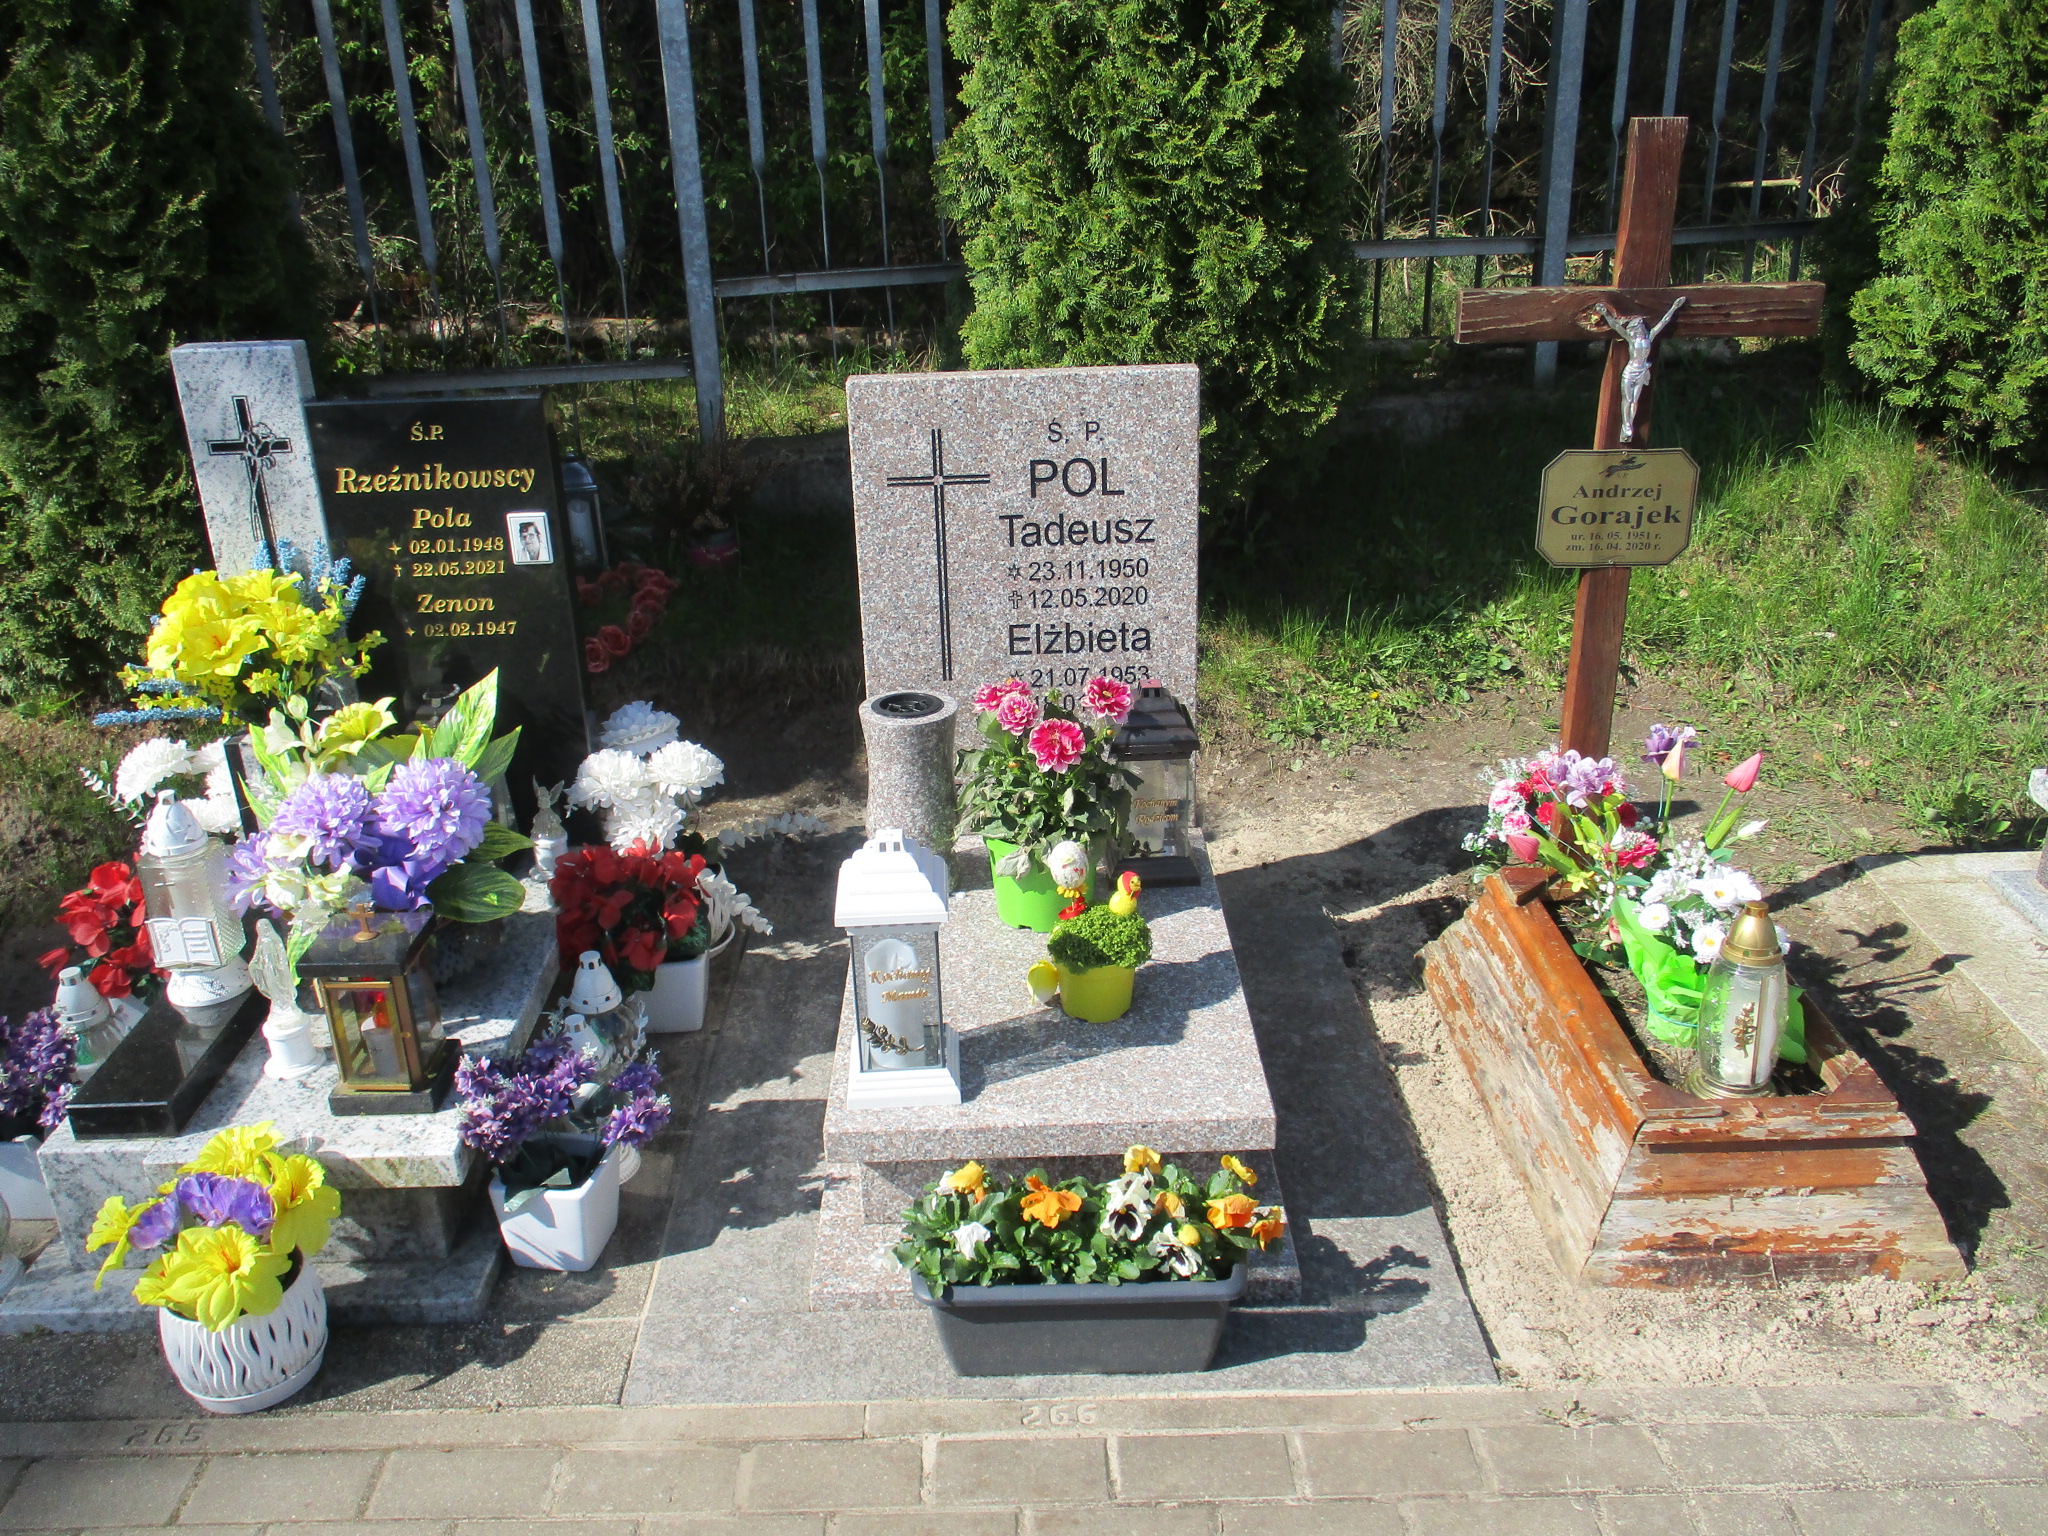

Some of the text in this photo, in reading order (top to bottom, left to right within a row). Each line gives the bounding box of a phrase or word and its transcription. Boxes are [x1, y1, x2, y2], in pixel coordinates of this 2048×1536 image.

[410, 421, 444, 441] Ś.P.
[335, 463, 535, 494] Rzeźnikowscy
[1029, 457, 1125, 498] POL
[1572, 483, 1663, 501] Andrzej
[412, 506, 472, 529] Pola
[1551, 505, 1682, 530] Gorajek
[999, 513, 1155, 548] Tadeusz
[1571, 533, 1585, 541] ur.
[1627, 531, 1650, 540] 1951
[409, 536, 504, 555] 02.01.1948
[1626, 542, 1651, 551] 2020
[412, 560, 505, 577] 22.05.2021
[1029, 558, 1149, 582] 23.11.1950
[417, 593, 495, 613] Zenon
[1029, 586, 1148, 609] 12.05.2020
[424, 620, 517, 637] 02.02.1947
[1008, 621, 1151, 656] Elżbieta
[1031, 665, 1149, 688] 21.071953
[1021, 1404, 1097, 1427] 266
[124, 1422, 208, 1446] 265
